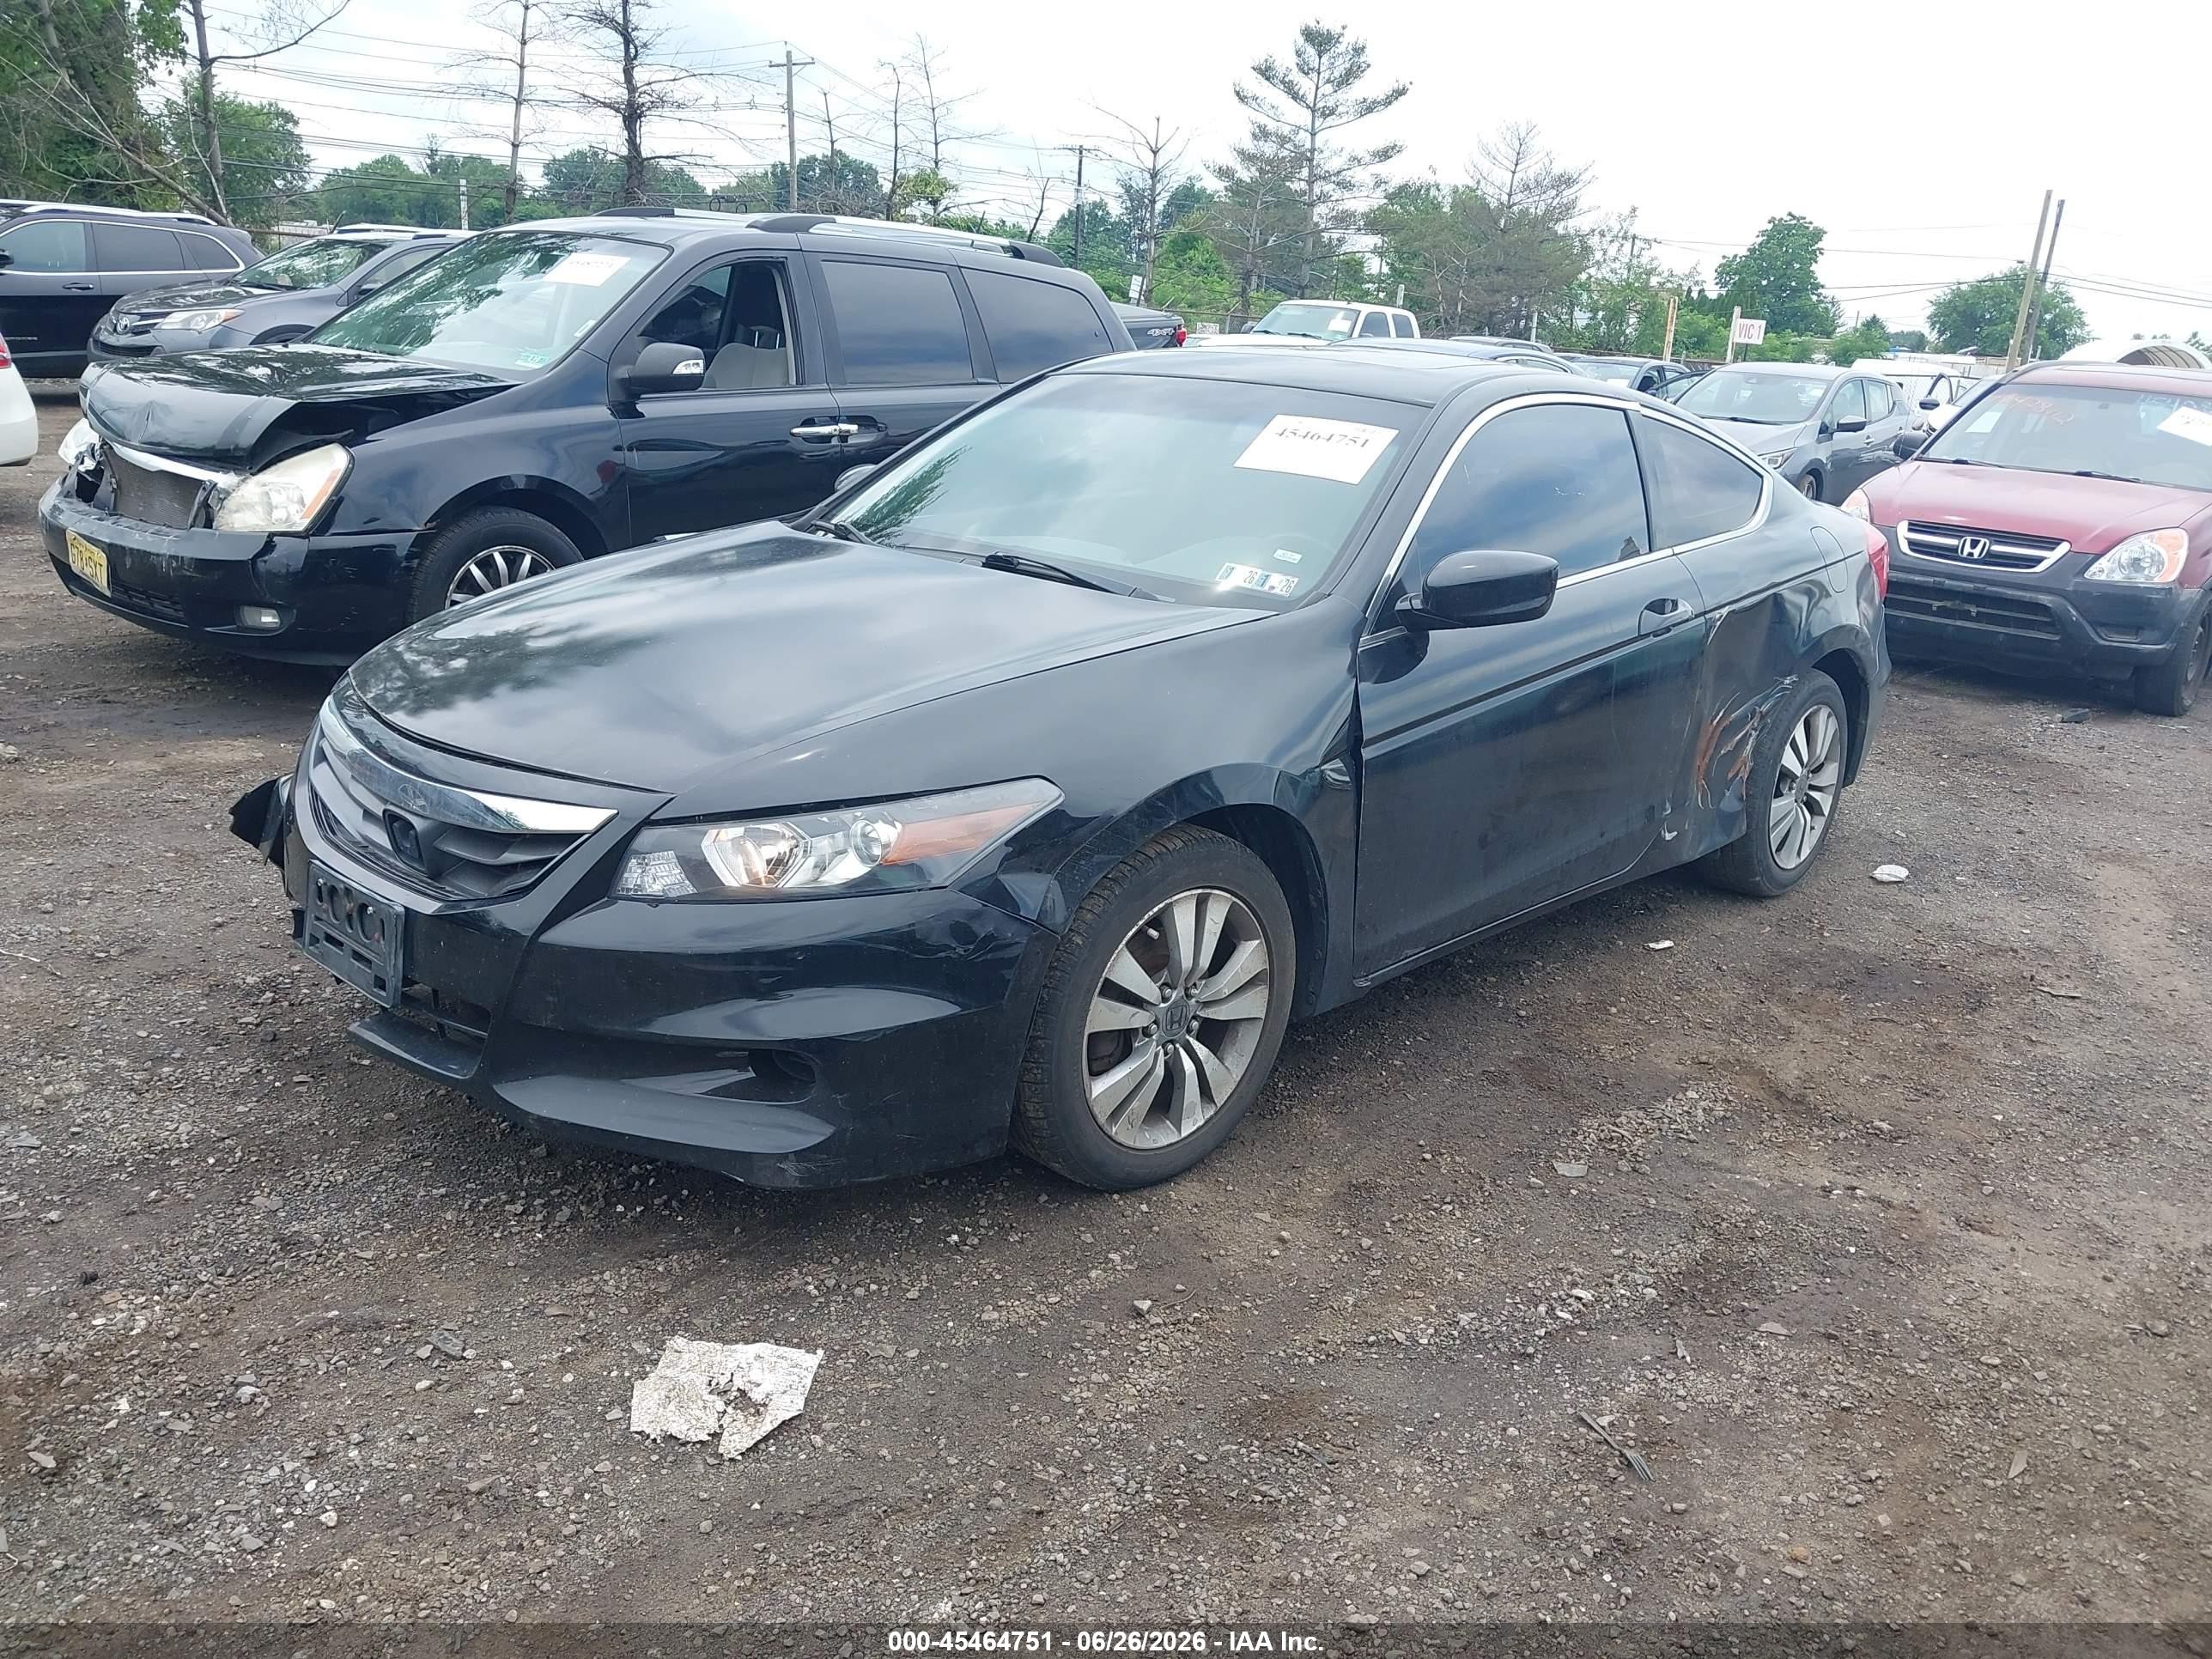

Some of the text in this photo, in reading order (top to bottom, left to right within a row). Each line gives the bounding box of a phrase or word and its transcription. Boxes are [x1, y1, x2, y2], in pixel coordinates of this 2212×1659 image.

[1738, 322, 1763, 340] VIC 1
[1274, 427, 1370, 448] 45464751
[1243, 570, 1258, 585] 26
[1279, 577, 1296, 593] 26
